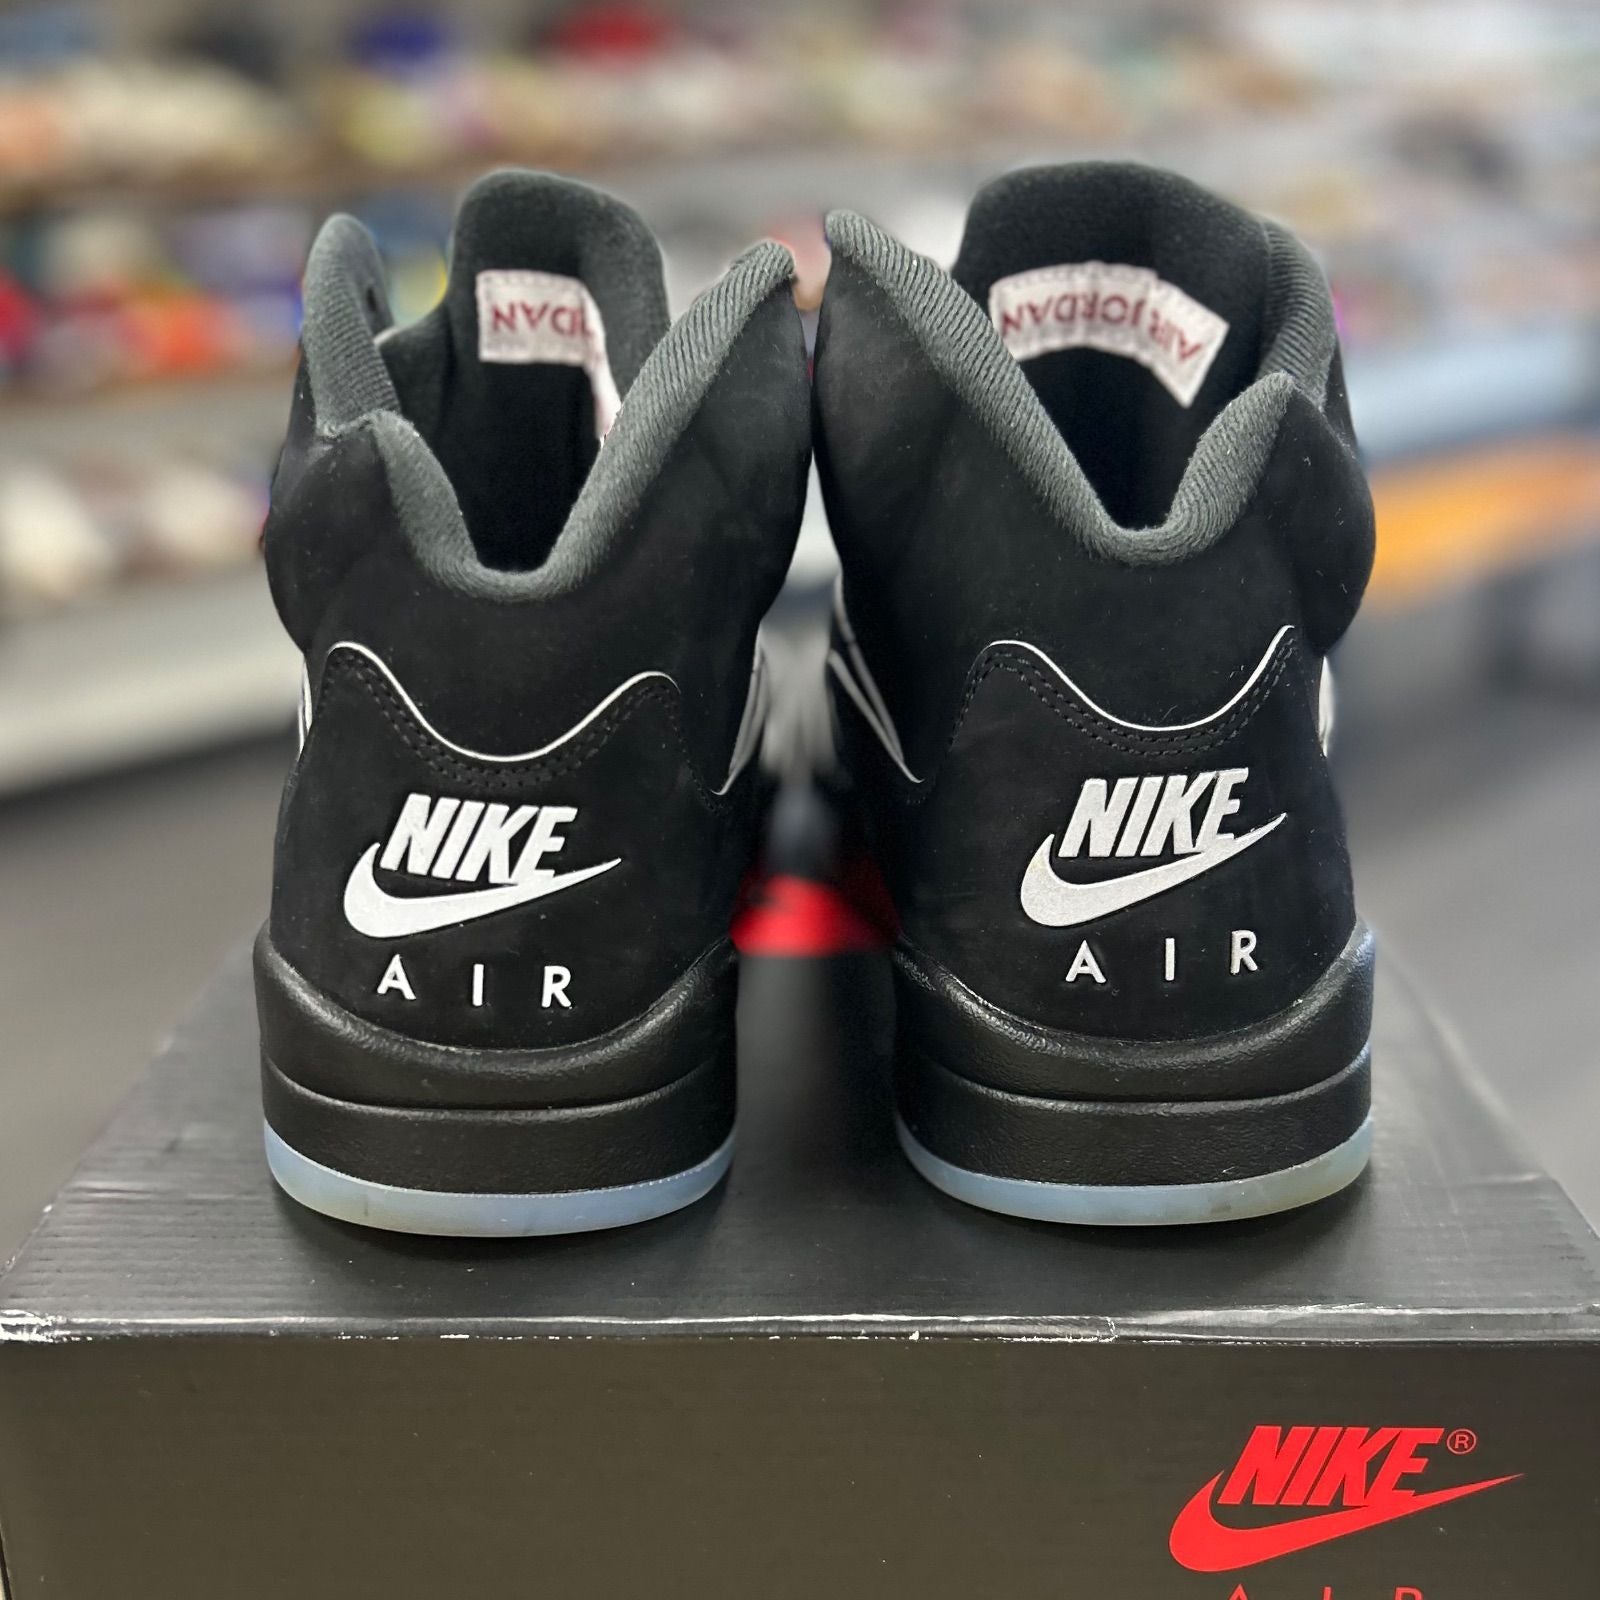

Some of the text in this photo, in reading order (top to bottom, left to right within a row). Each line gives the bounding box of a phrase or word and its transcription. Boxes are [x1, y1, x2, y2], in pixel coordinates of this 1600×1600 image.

[1001, 292, 1146, 338] JORDAN
[380, 793, 578, 884] NIKE
[1058, 767, 1249, 858] NIKE
[377, 954, 571, 1008] AIR
[1065, 930, 1258, 983] AIR
[1217, 1425, 1445, 1507] NIKE
